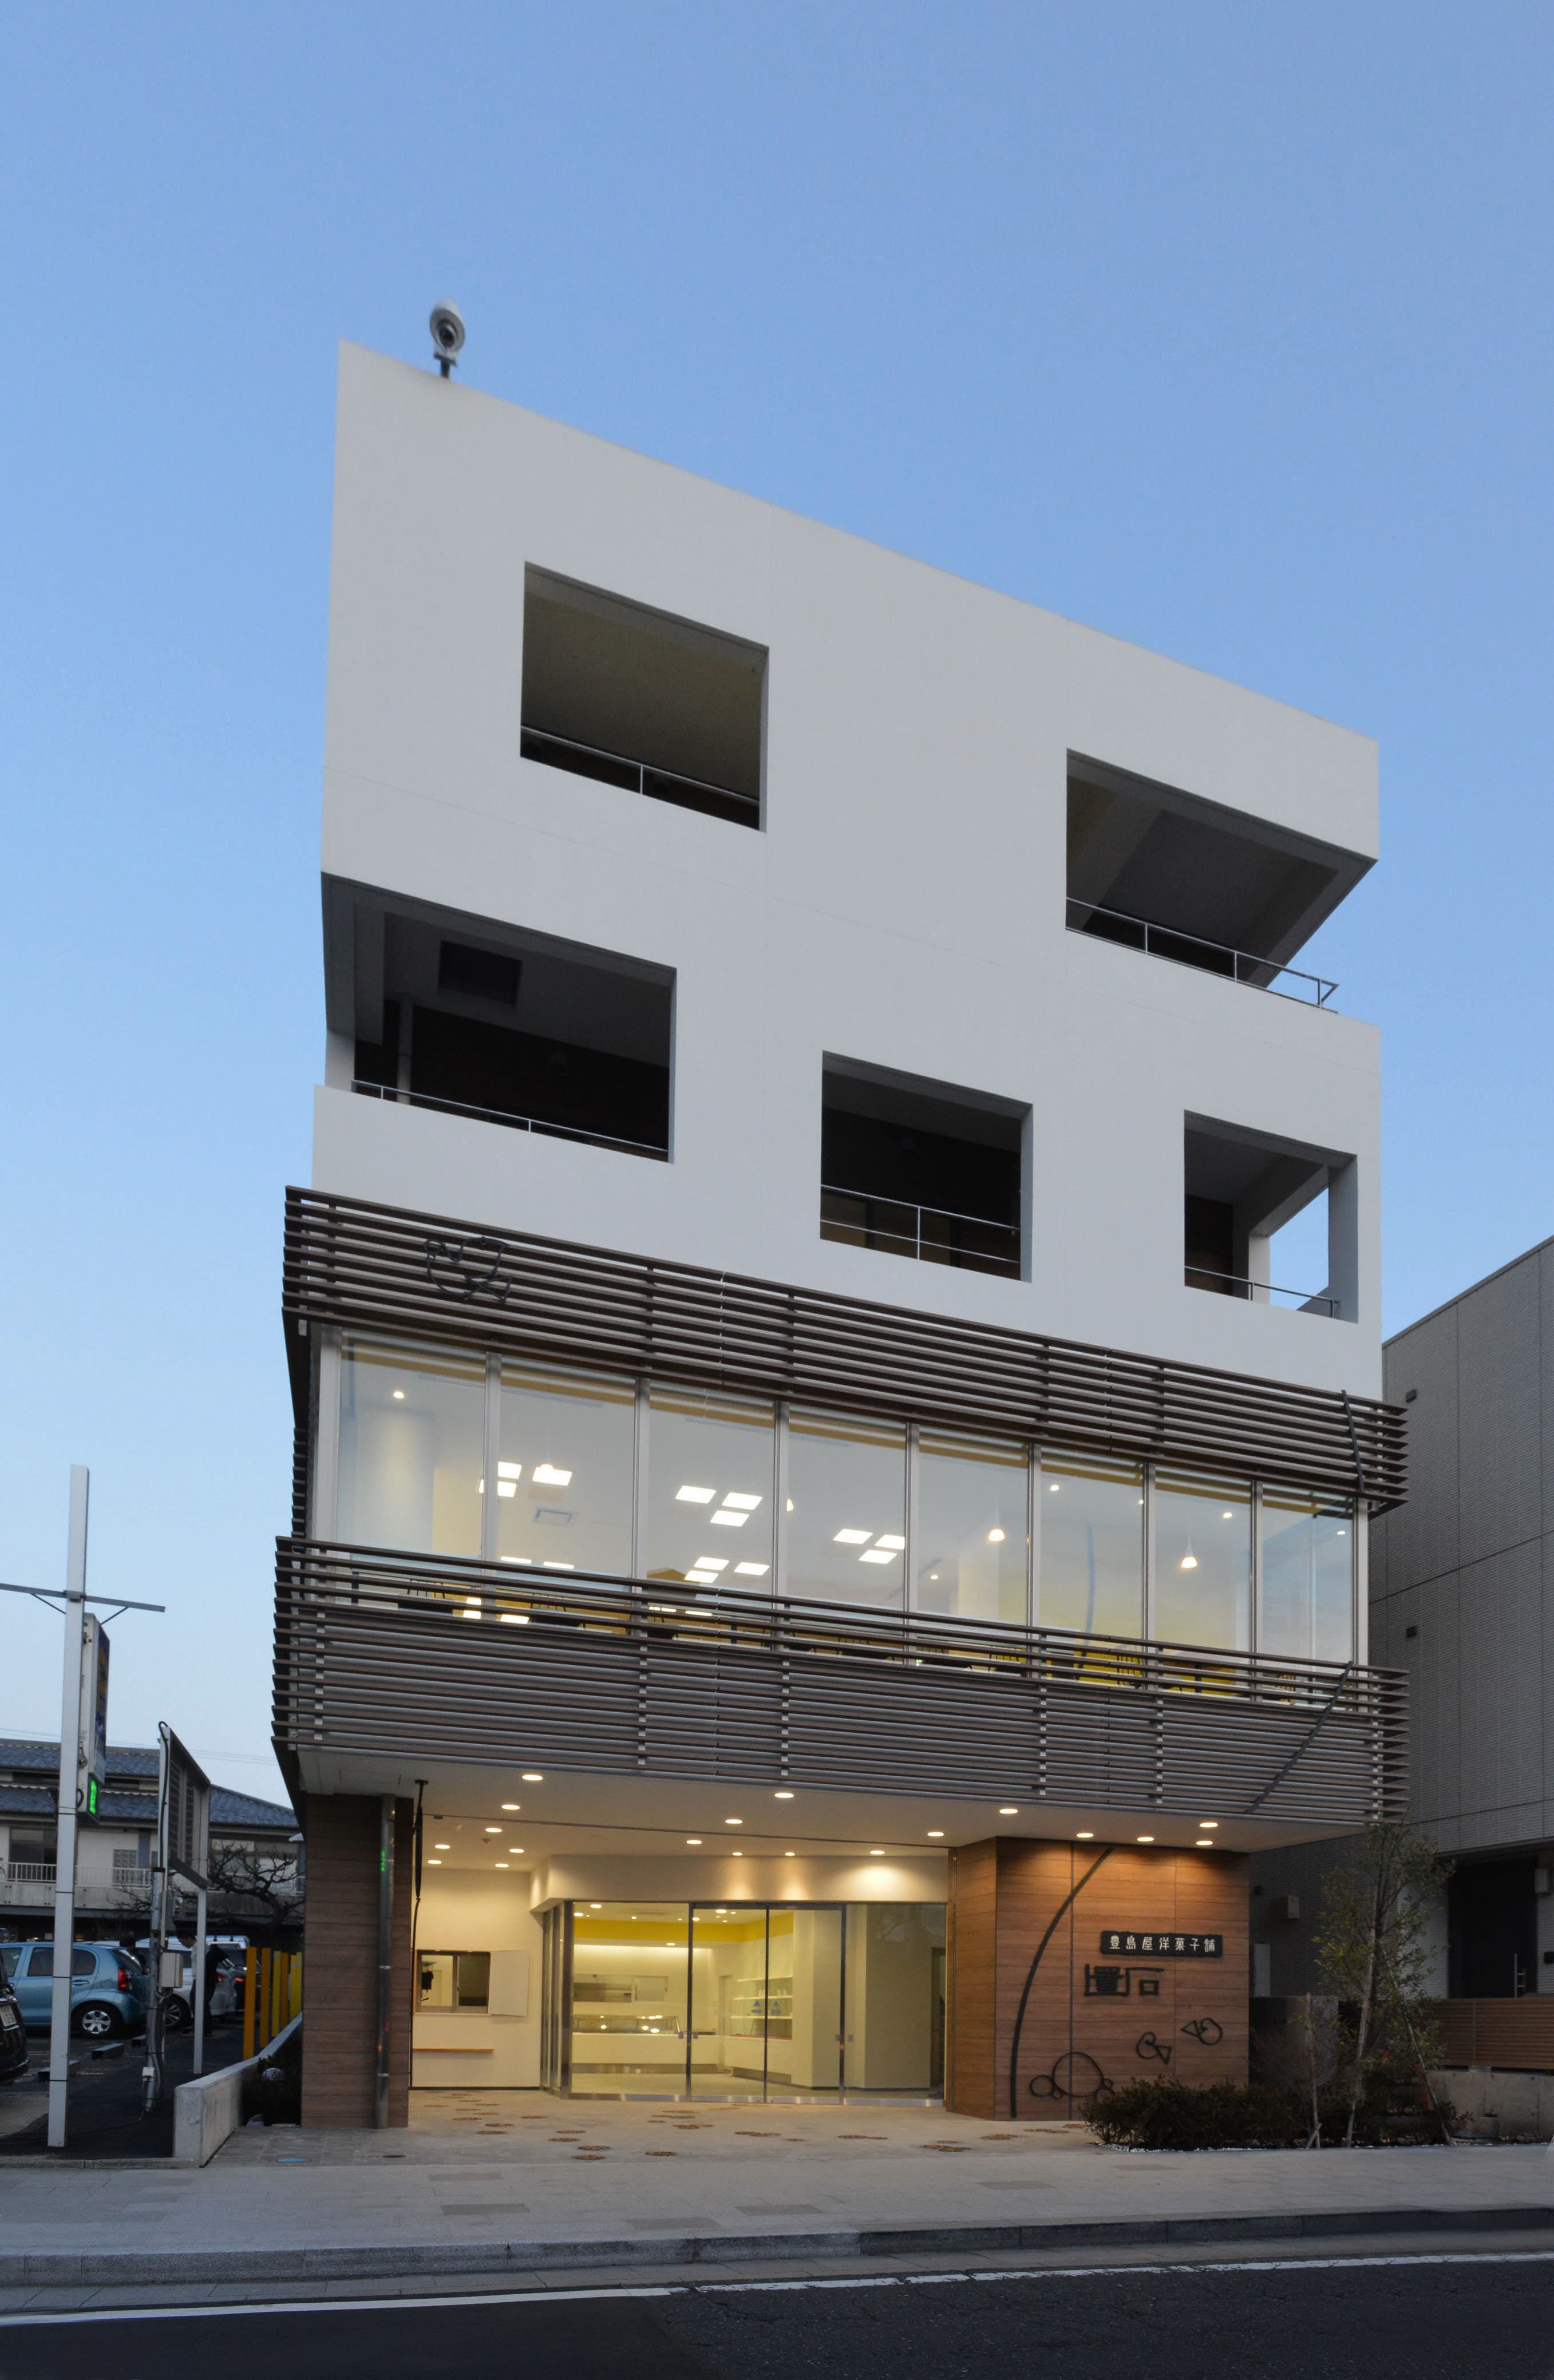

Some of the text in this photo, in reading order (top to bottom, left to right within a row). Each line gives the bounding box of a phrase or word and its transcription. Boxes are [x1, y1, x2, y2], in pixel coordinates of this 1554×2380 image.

[1109, 1935, 1215, 1953] 豊島屋洋菓子舗
